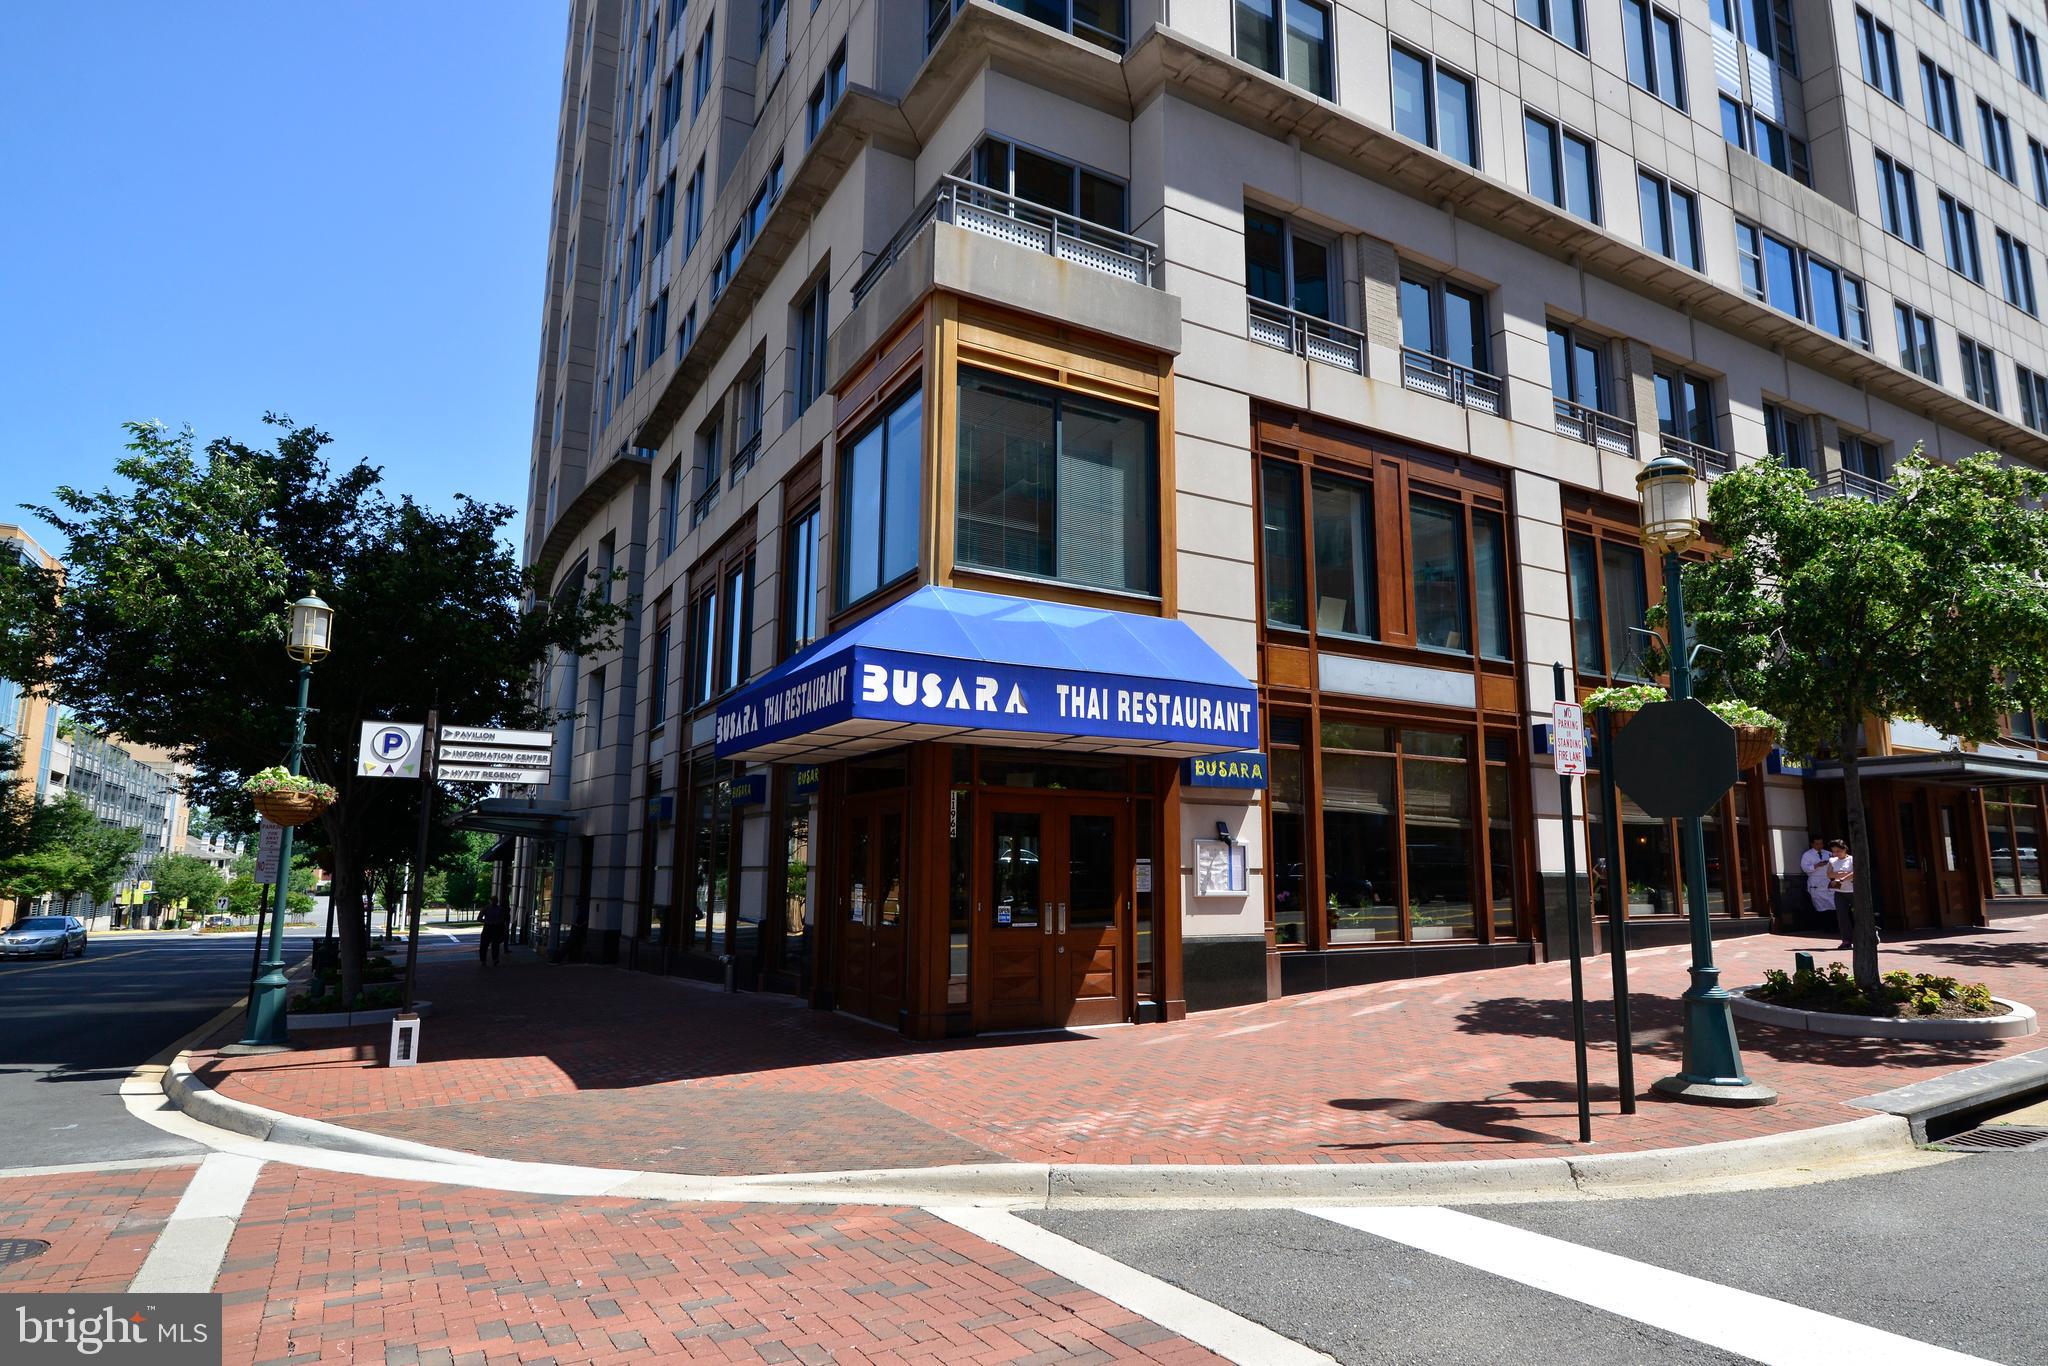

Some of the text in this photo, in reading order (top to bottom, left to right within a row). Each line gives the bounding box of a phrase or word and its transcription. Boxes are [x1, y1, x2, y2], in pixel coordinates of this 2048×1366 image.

[717, 665, 847, 744] BUSARA THAI RESTAURANT
[863, 664, 1250, 733] BUSARA THAI RESTAURANT
[1563, 707, 1572, 718] NO
[1558, 719, 1578, 730] PARKING
[454, 730, 495, 740] PAVILION
[383, 732, 403, 753] P
[1557, 738, 1581, 749] STANDING
[452, 750, 548, 763] INFORMATION CENTER
[1558, 750, 1581, 762] FIRE LANE
[451, 769, 522, 781] HYATT REGENCY
[1195, 759, 1263, 779] BUSARA
[797, 767, 820, 785] BUSAR
